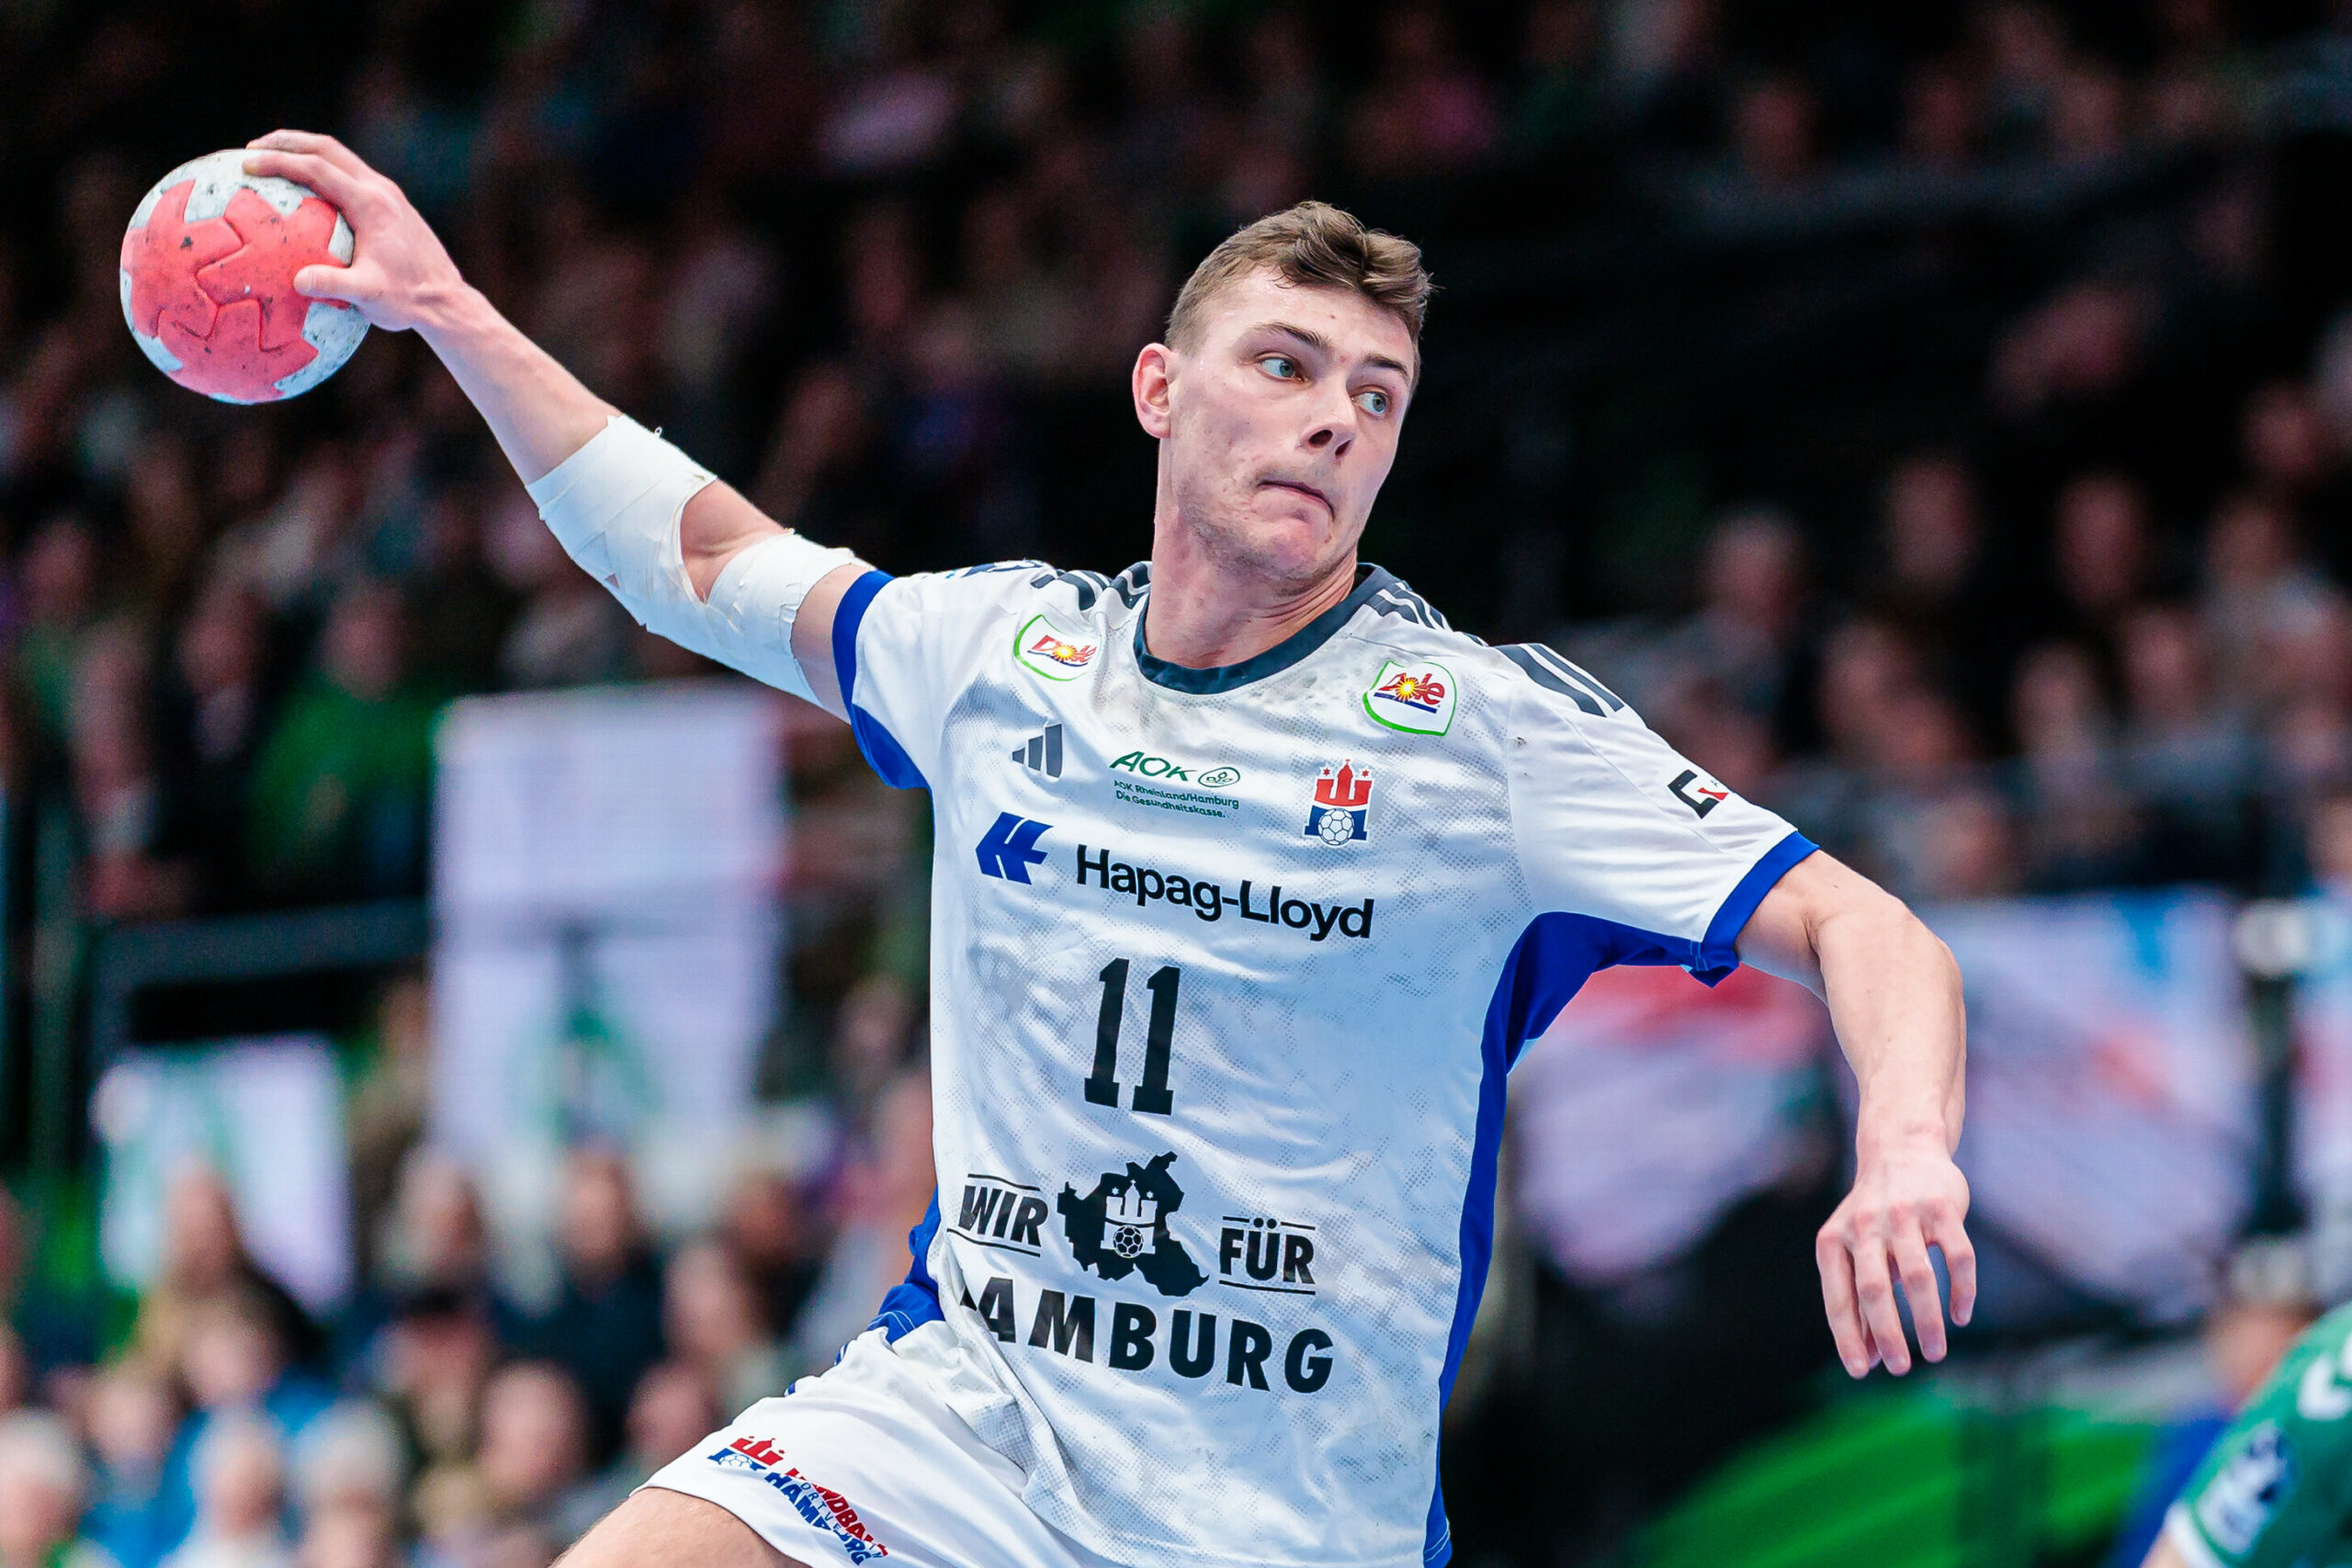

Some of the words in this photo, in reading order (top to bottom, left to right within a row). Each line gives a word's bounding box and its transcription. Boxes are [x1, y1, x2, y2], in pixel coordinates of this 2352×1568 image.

[1109, 750, 1198, 782] AOK
[1114, 779, 1134, 793] AOK
[1135, 784, 1239, 810] Rheinland/Hamburg
[1115, 790, 1131, 802] Die
[1076, 843, 1375, 942] Hapag-Lloyd
[1084, 957, 1181, 1116] 11
[957, 1184, 1048, 1248] WIR
[1219, 1216, 1316, 1285] FÜR
[959, 1276, 1334, 1394] AMBURG
